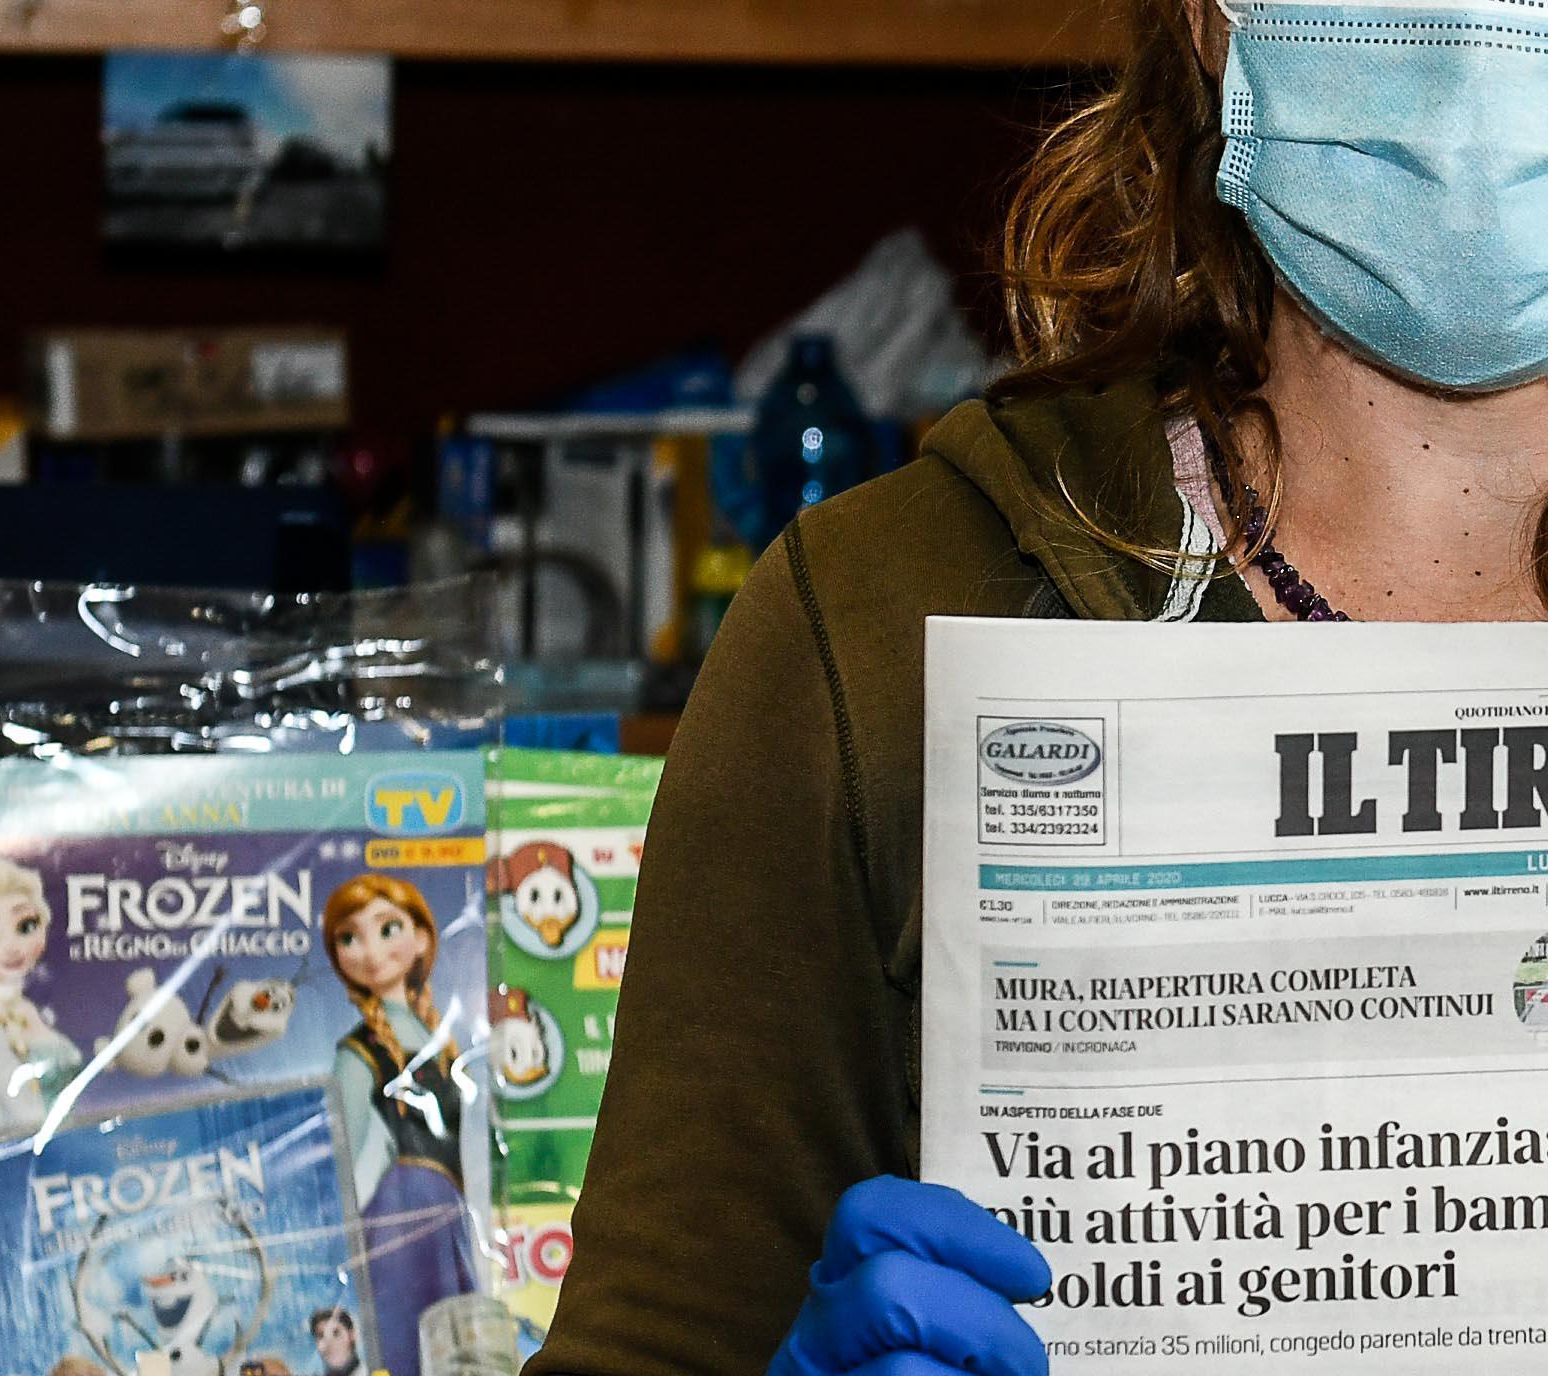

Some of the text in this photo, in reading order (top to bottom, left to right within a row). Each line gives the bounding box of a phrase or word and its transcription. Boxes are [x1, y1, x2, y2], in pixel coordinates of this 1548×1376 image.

[1455, 706, 1543, 720] QUOTIDIANO
[986, 740, 1090, 762] GALARDI
[1274, 732, 1377, 837] IL
[374, 789, 456, 825] TV
[66, 869, 312, 933] FROZEN
[1463, 884, 1540, 898] www.iltirreno.it
[995, 965, 1417, 1002] MURA, RIAPERTURA COMPLETA
[995, 993, 1494, 1033] MA I CONTROLLI SARANNO CONTINUI
[982, 1129, 1073, 1181] Via
[1086, 1129, 1133, 1181] al
[1148, 1127, 1306, 1190] piano
[31, 1140, 265, 1229] FROZEN
[1085, 1191, 1284, 1245] attività
[1296, 1197, 1391, 1250] per
[1402, 1184, 1420, 1235] i
[1176, 1254, 1225, 1307] ai
[1237, 1250, 1460, 1318] genitori
[1084, 1335, 1157, 1358] stanzia
[1161, 1335, 1190, 1356] 35
[1194, 1332, 1265, 1358] milioni,
[1269, 1329, 1356, 1356] congedo
[1359, 1326, 1454, 1354] parentale
[1457, 1324, 1483, 1348] da
[1487, 1325, 1547, 1346] trenta
